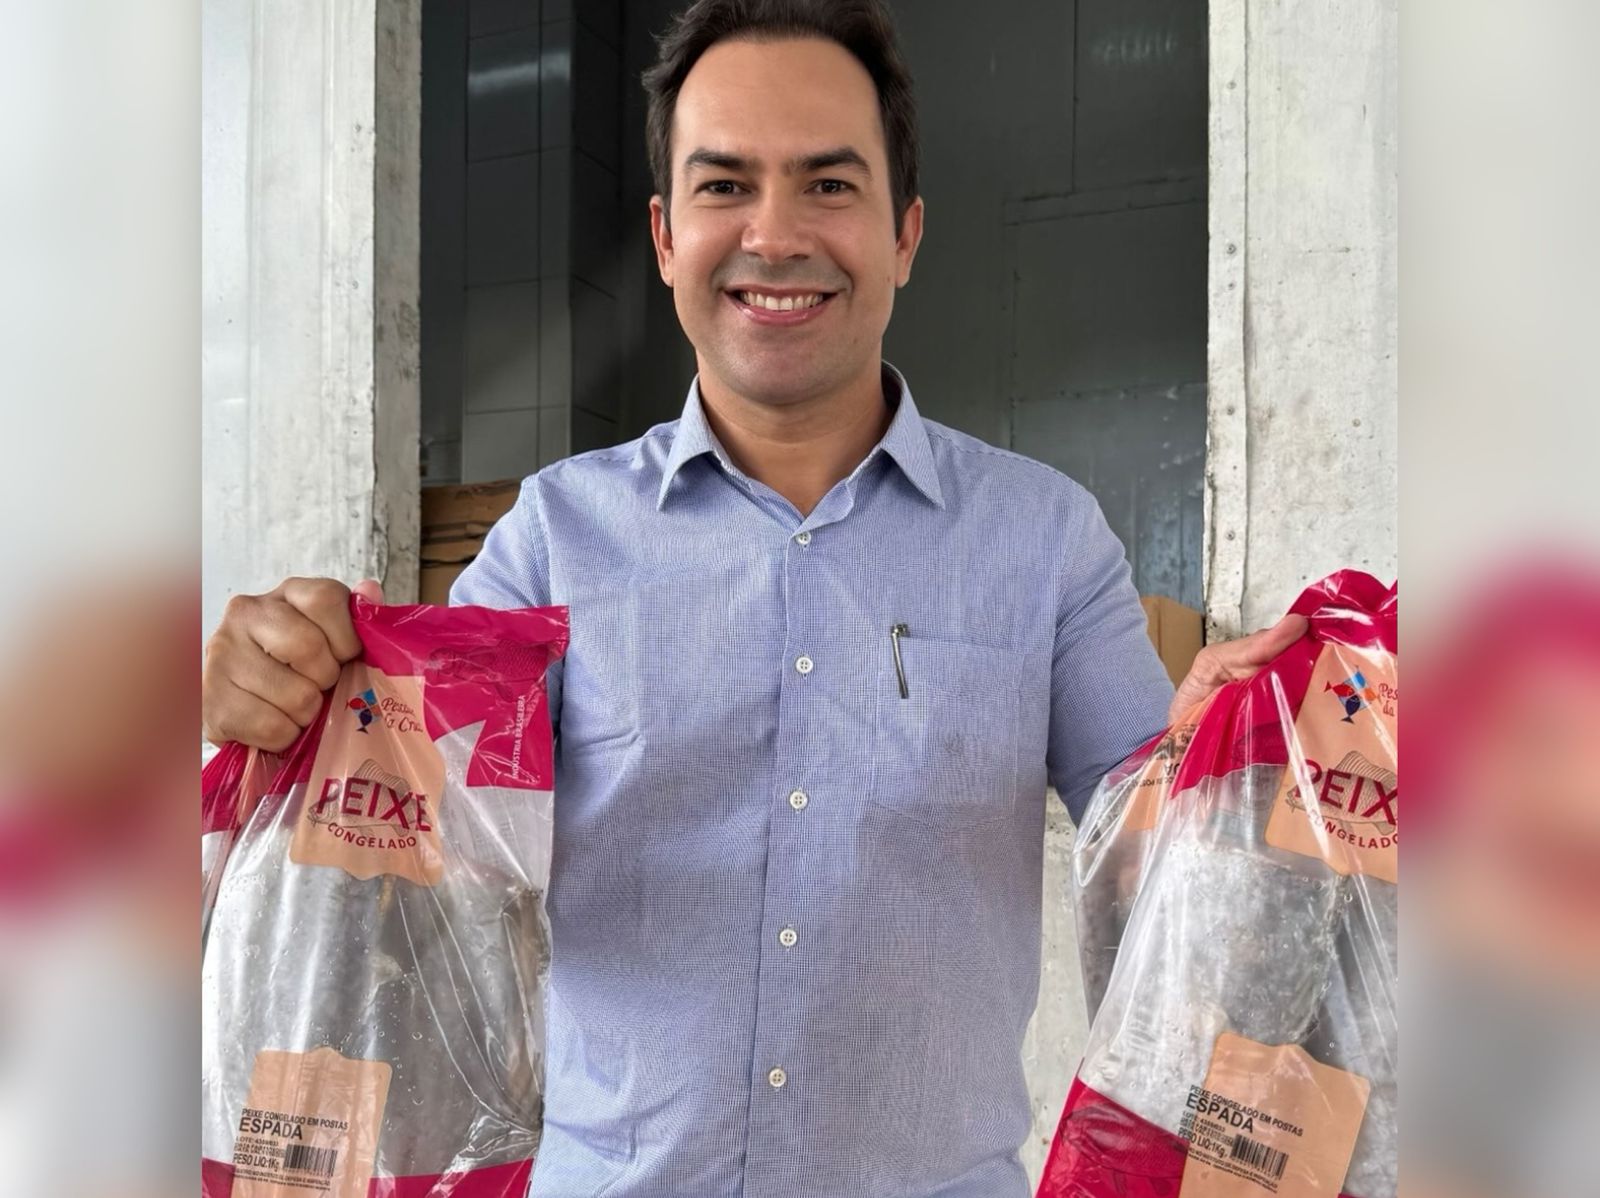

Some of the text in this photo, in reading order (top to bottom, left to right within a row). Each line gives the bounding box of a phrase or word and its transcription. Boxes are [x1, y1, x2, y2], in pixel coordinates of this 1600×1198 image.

[316, 777, 432, 832] PEIXE
[327, 822, 417, 849] CONGELADO
[241, 1108, 349, 1130] PEIXE CONGELADO EM POSTAS
[1186, 1093, 1254, 1134] ESPADA
[1189, 1084, 1304, 1137] PEIXE CONGELADO EM POSTAS
[239, 1118, 303, 1140] ESPADA
[232, 1153, 253, 1165] PESO
